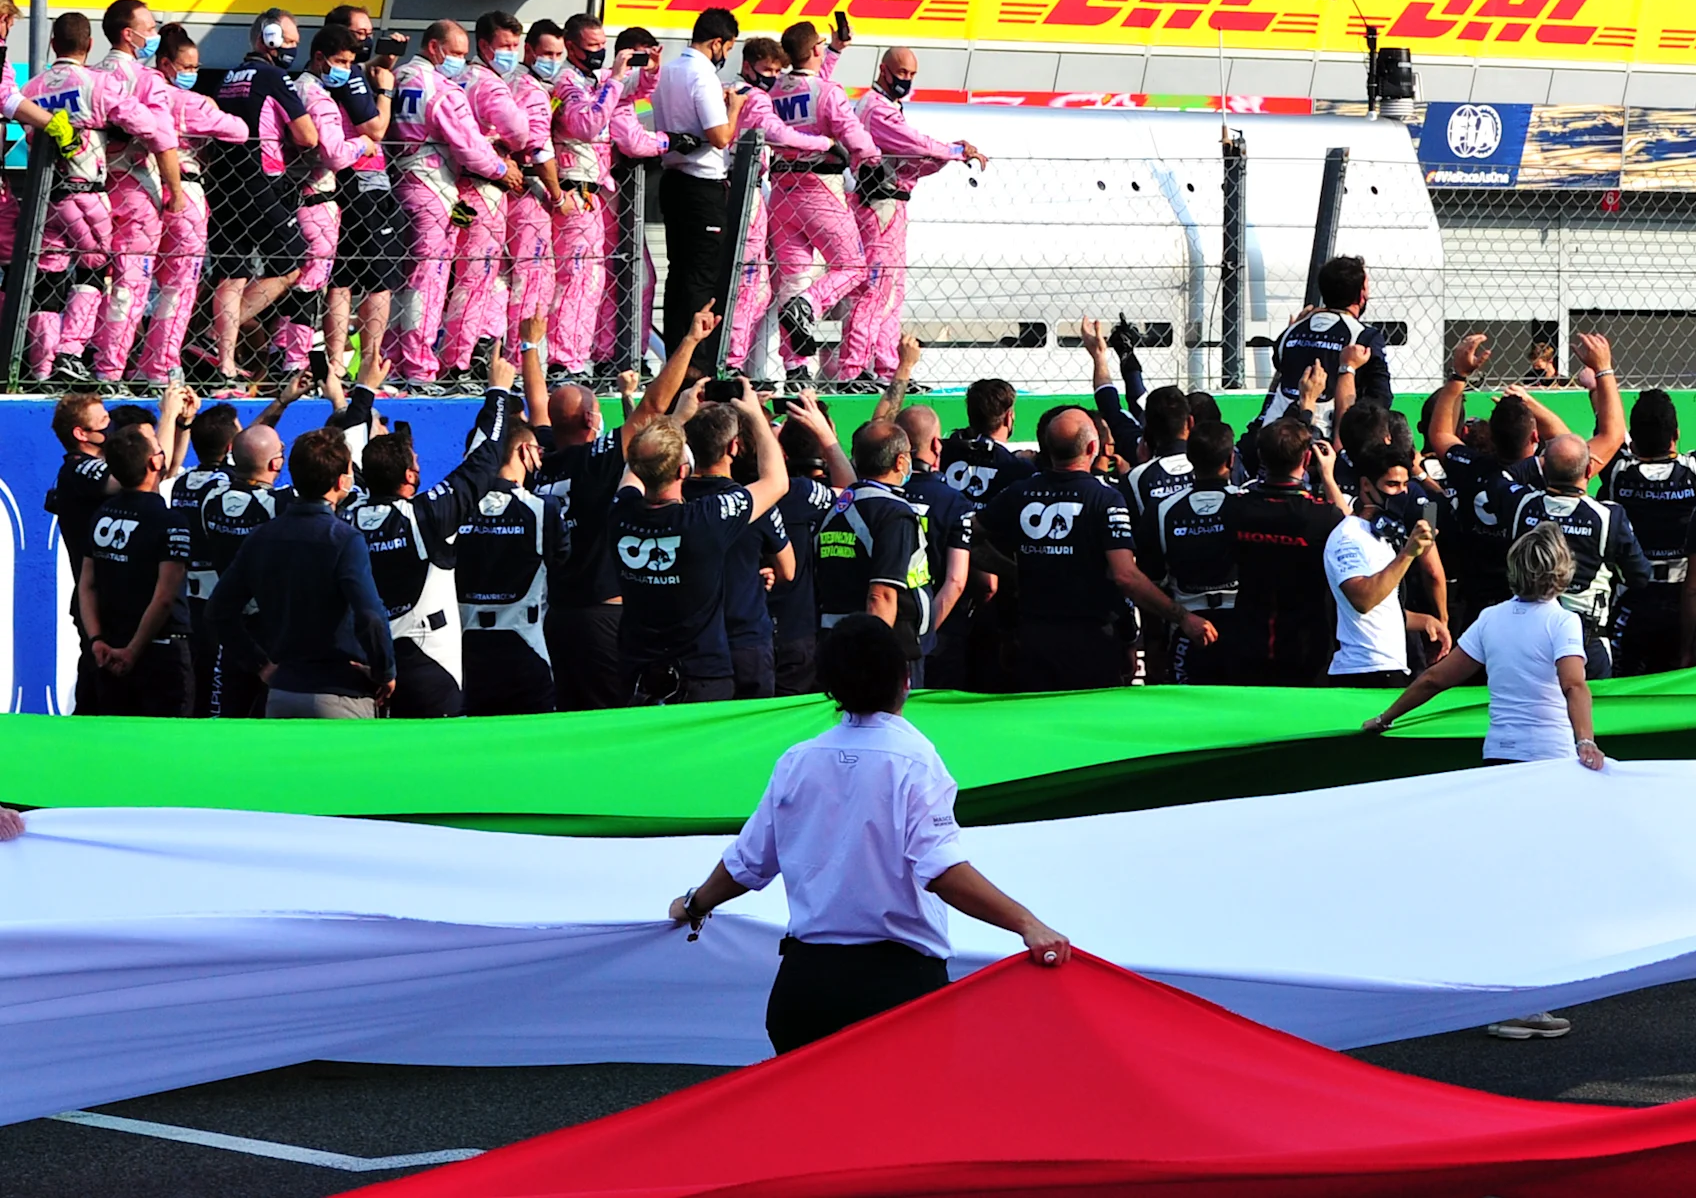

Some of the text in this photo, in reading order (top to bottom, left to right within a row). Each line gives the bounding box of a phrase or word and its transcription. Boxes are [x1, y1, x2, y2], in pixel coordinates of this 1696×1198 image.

[33, 89, 81, 114] WT
[774, 93, 811, 124] WT
[1450, 111, 1499, 152] FIA
[1634, 488, 1695, 500] ALPHATAURI
[474, 525, 524, 535] ALPHATAURI
[1188, 524, 1225, 536] ALPHATA
[1237, 531, 1308, 546] HONDA
